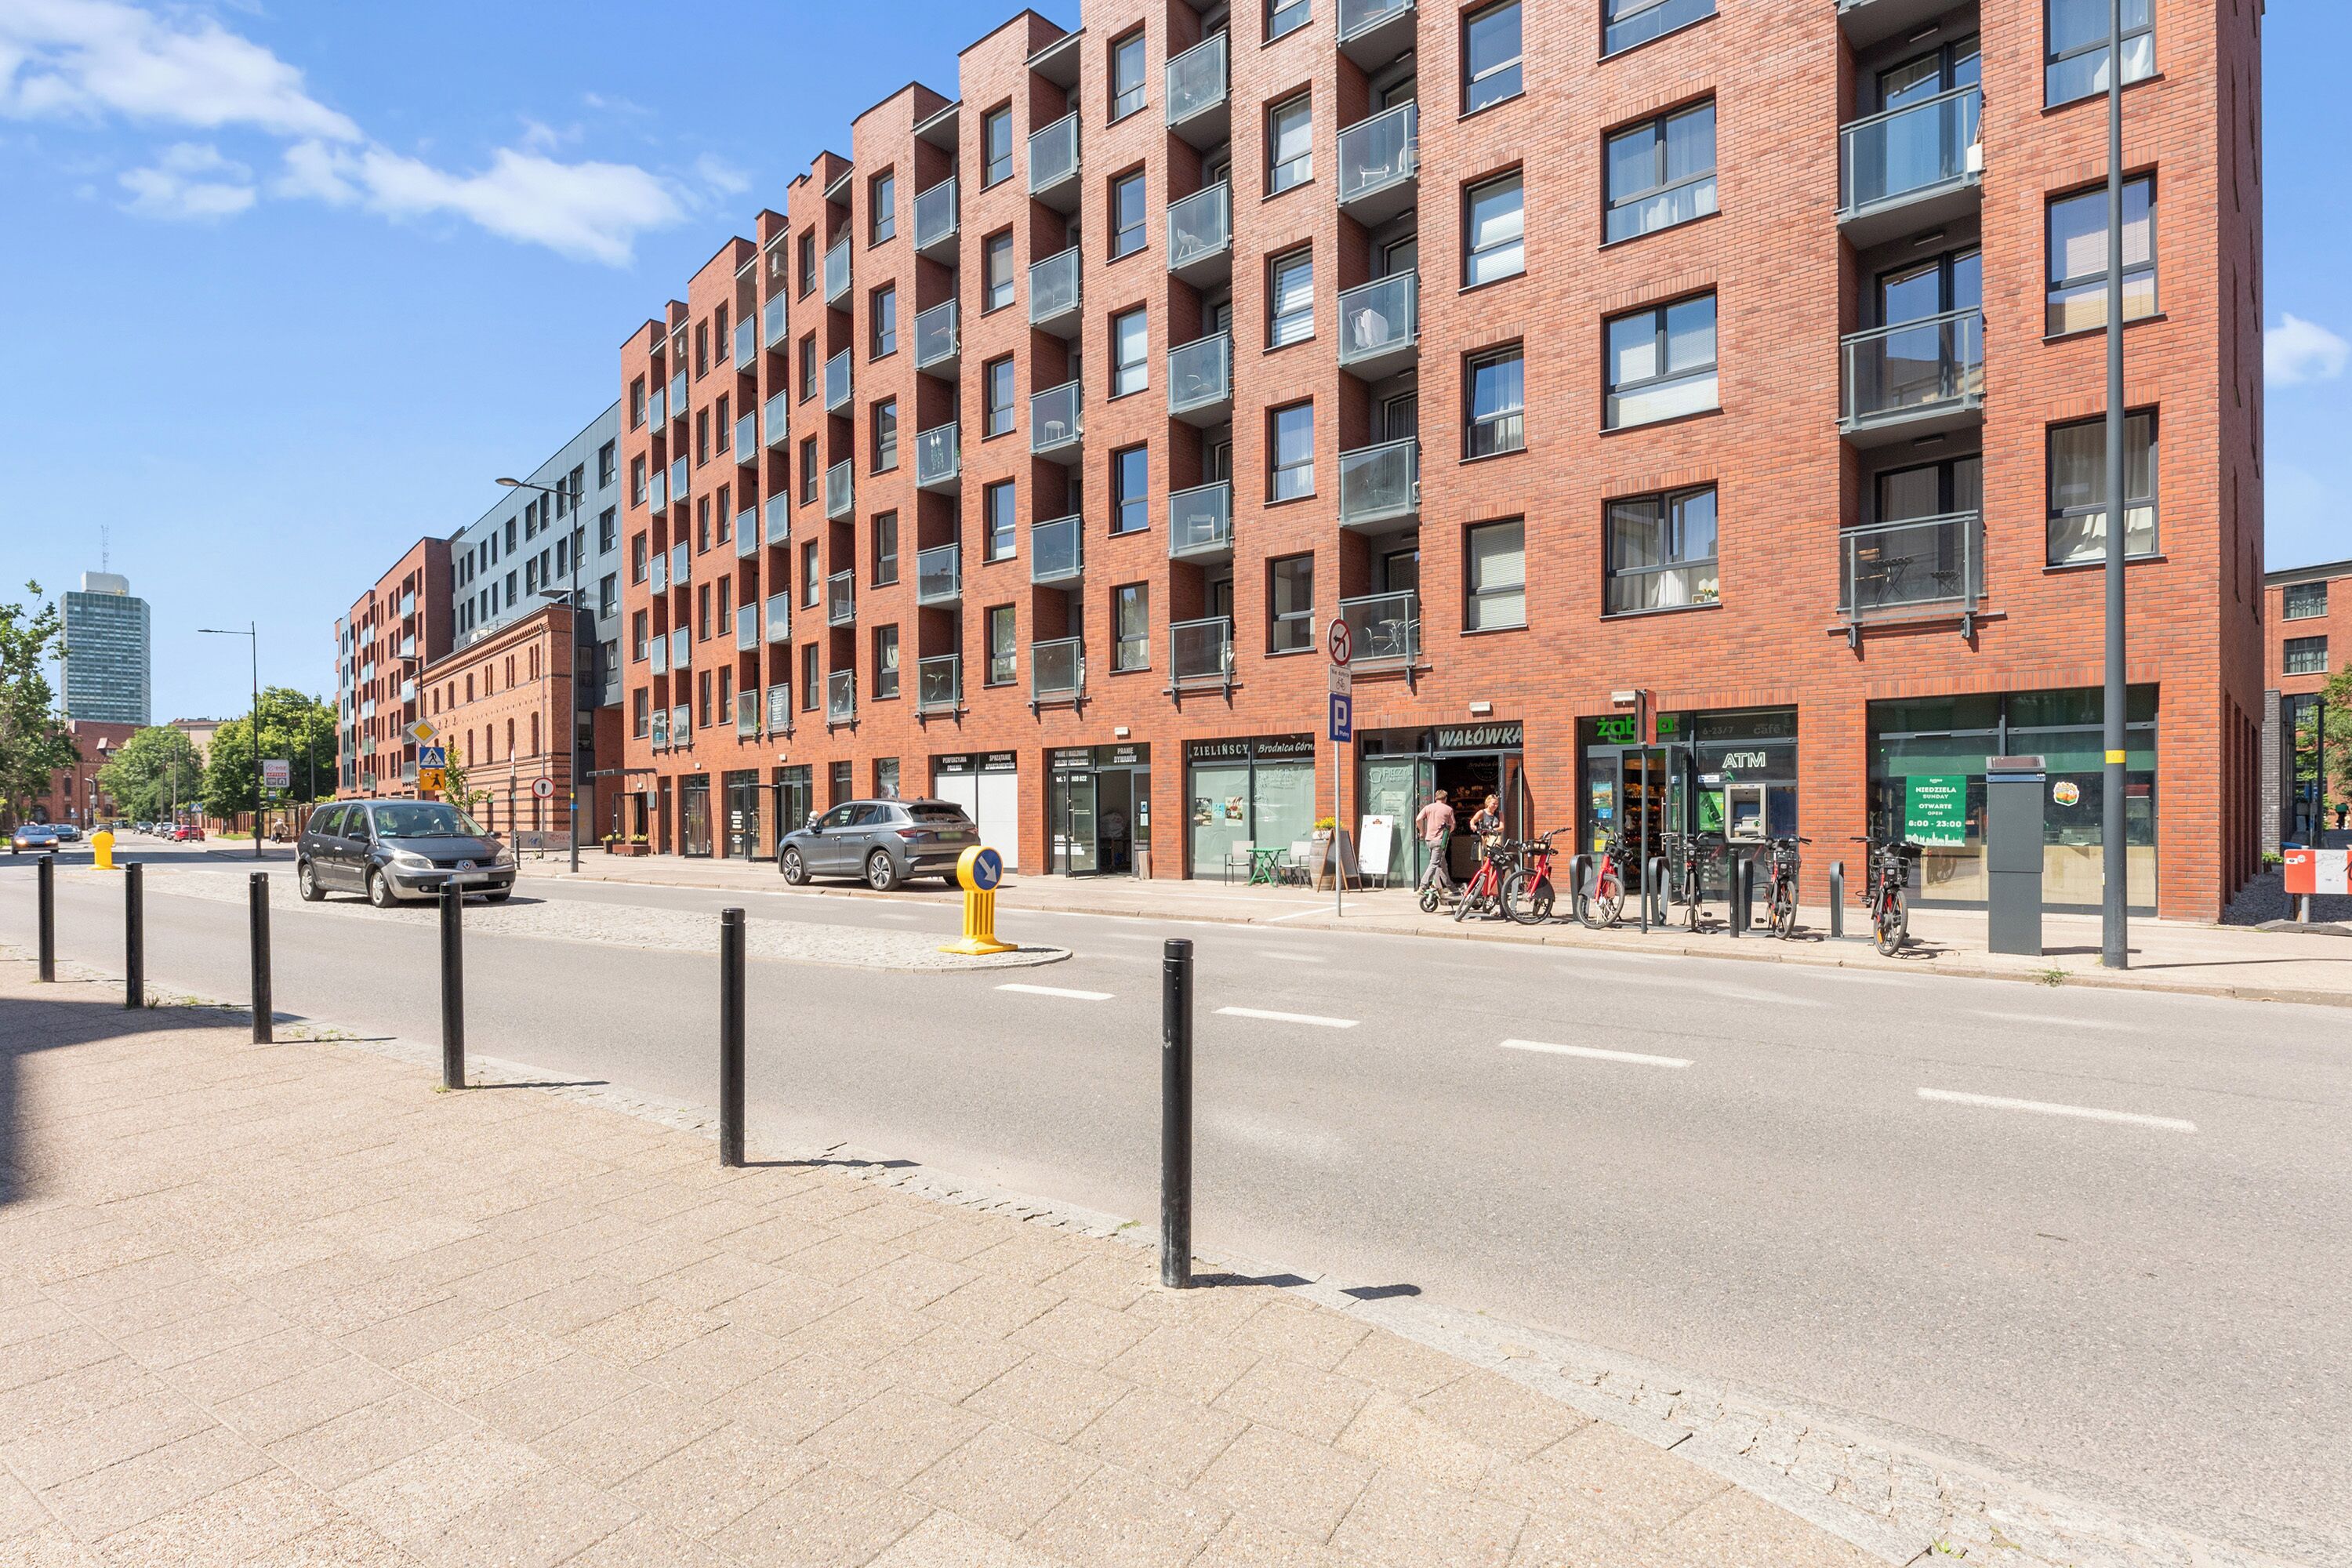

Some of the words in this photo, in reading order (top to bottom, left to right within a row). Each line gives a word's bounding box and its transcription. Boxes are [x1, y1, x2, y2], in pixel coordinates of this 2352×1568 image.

[1334, 699, 1347, 735] P
[1597, 715, 1674, 736] żaba
[1439, 727, 1523, 746] WAŁÓWKA
[1193, 743, 1249, 756] ZIELIŃSCY
[1258, 742, 1294, 753] Brodnica
[1722, 752, 1766, 768] ATM
